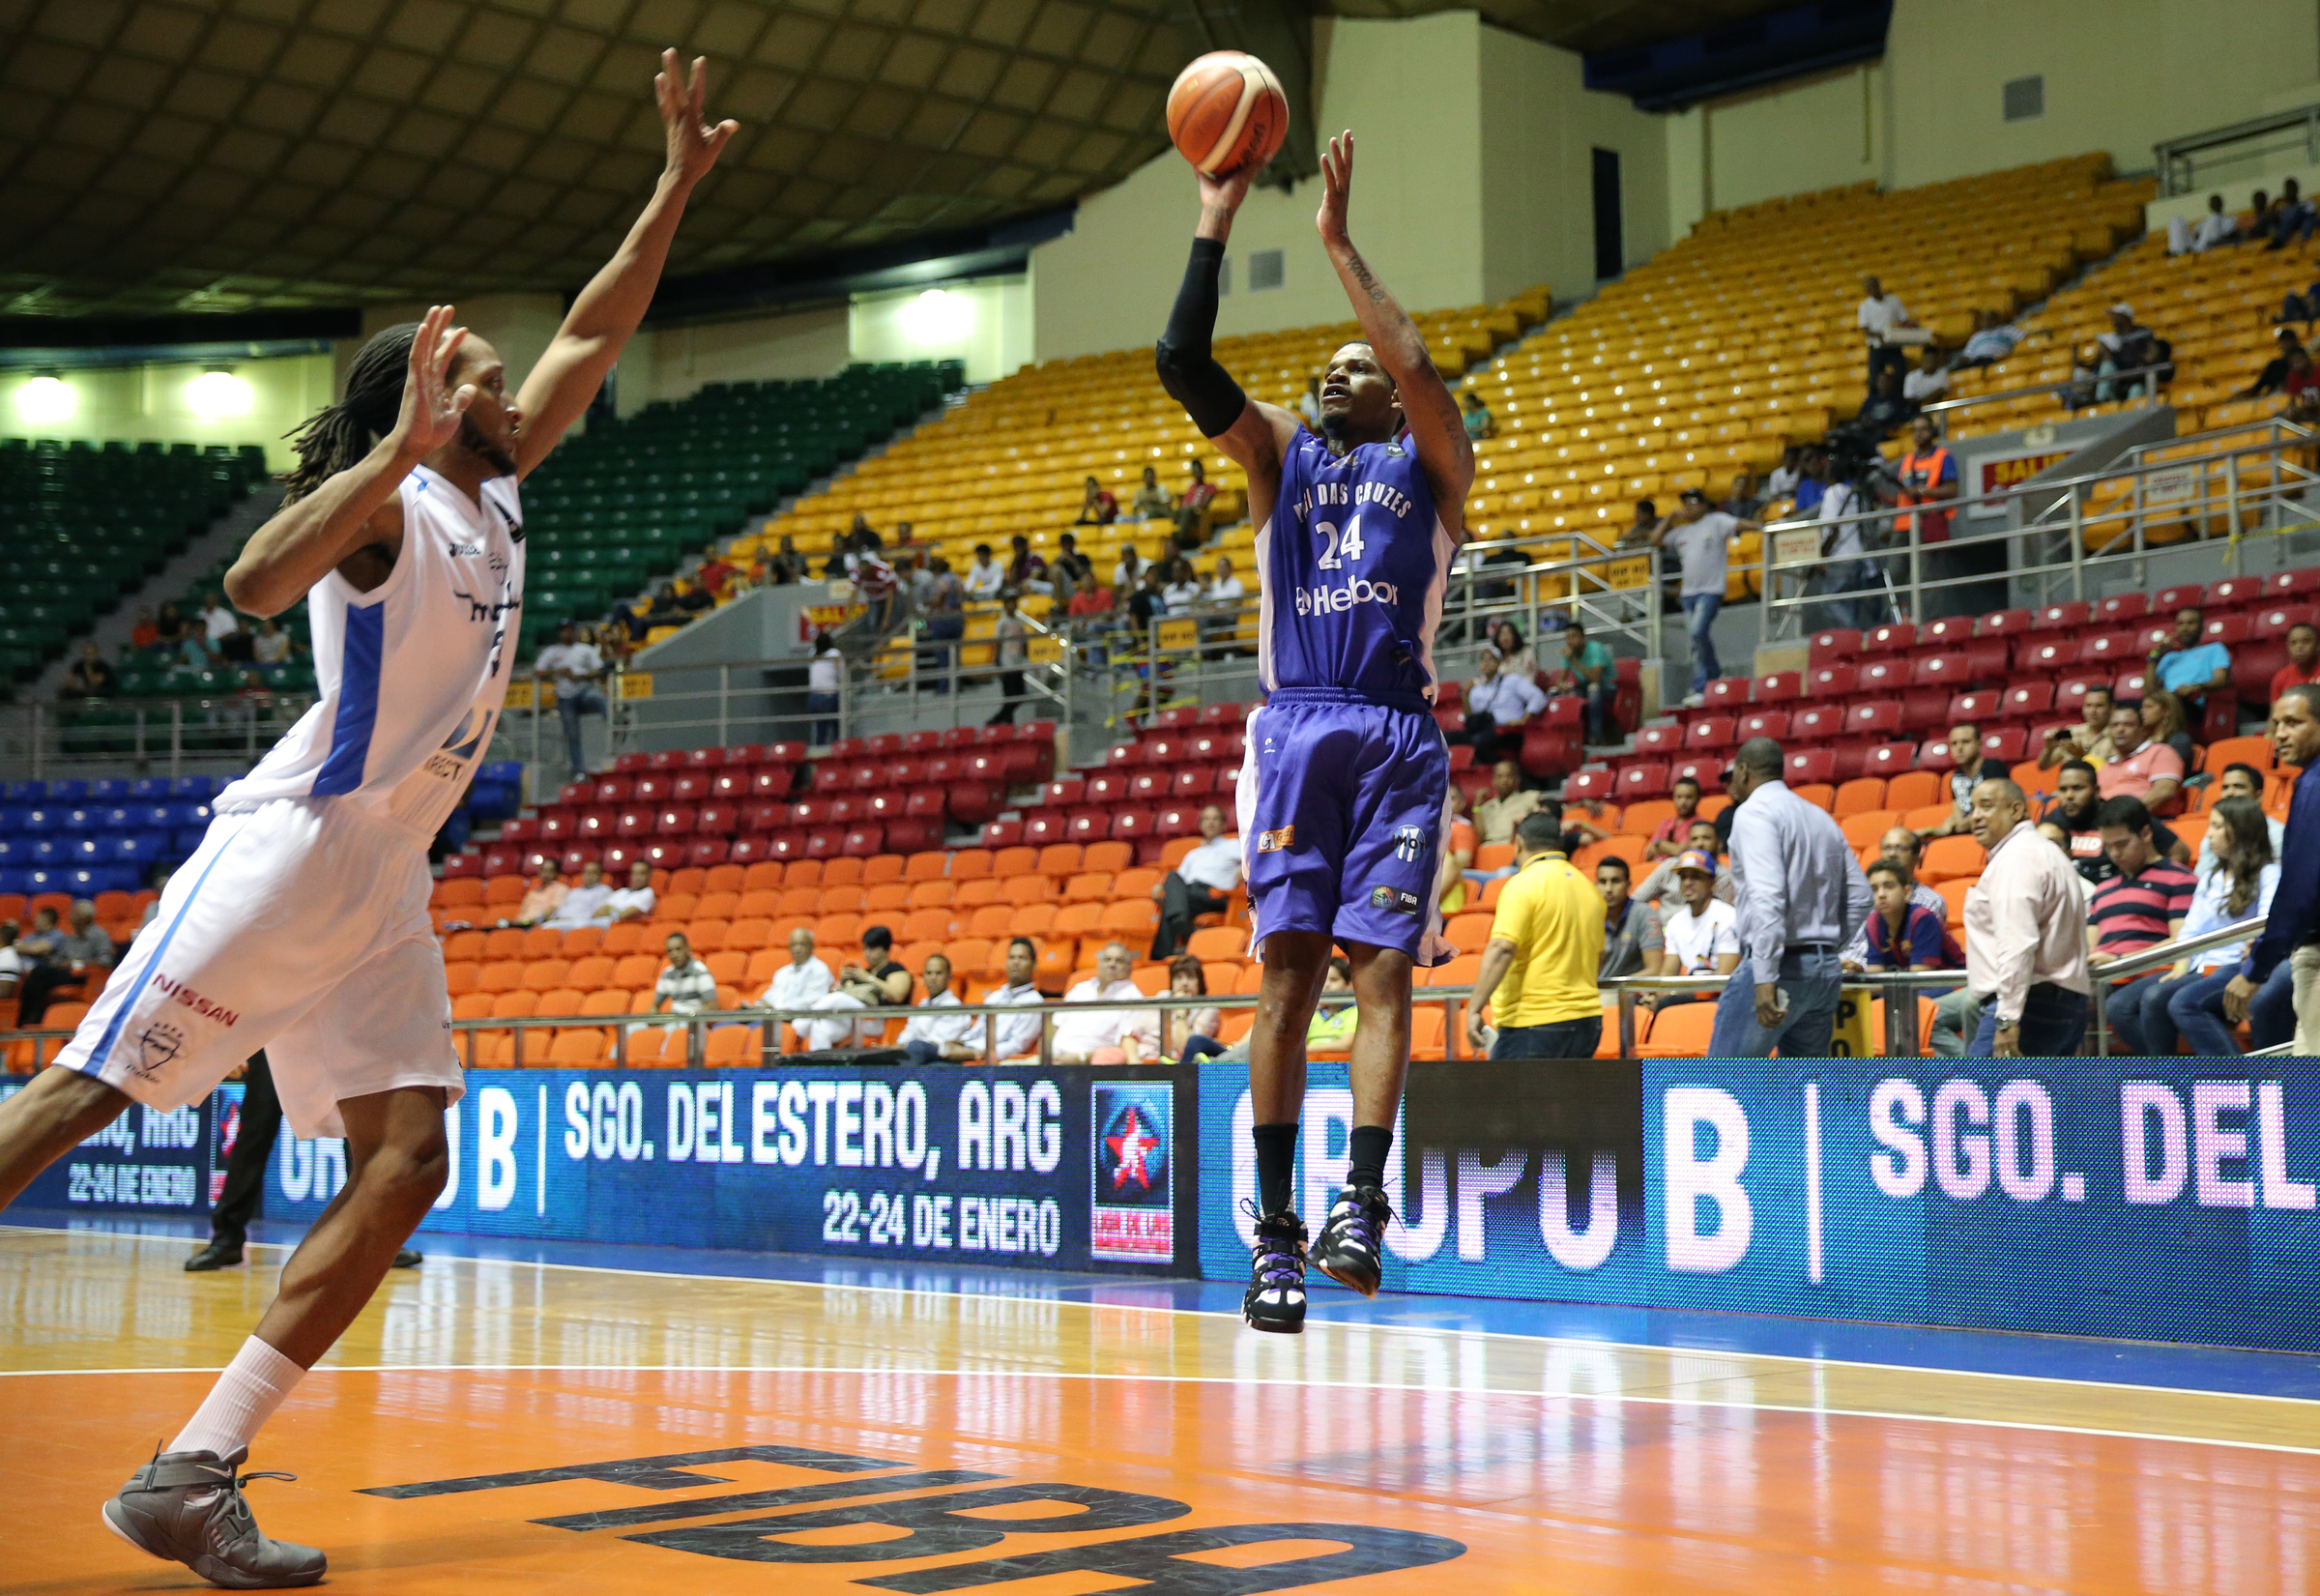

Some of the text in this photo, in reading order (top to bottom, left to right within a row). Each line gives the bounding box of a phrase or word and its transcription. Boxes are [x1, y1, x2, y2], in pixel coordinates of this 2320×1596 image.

[1318, 482, 1348, 506] DAS
[1355, 480, 1411, 519] CRUZES
[1315, 513, 1365, 570] 24
[1400, 892, 1418, 906] FIBA
[152, 972, 241, 1029] NISSAN
[477, 1088, 517, 1211] B
[565, 1080, 654, 1161] SGO.
[667, 1081, 743, 1164] DEL
[752, 1080, 942, 1181] ESTERO,
[958, 1080, 1061, 1174] ARG
[68, 1163, 196, 1206] 22-24 DE ENERO
[1664, 1086, 1753, 1274] B
[1869, 1077, 2086, 1203] SGO.
[2121, 1079, 2318, 1210] DEL
[823, 1189, 906, 1246] 22-24
[913, 1193, 953, 1250] DE
[958, 1194, 1061, 1257] ENERO
[352, 1443, 1468, 1596] FIBA
